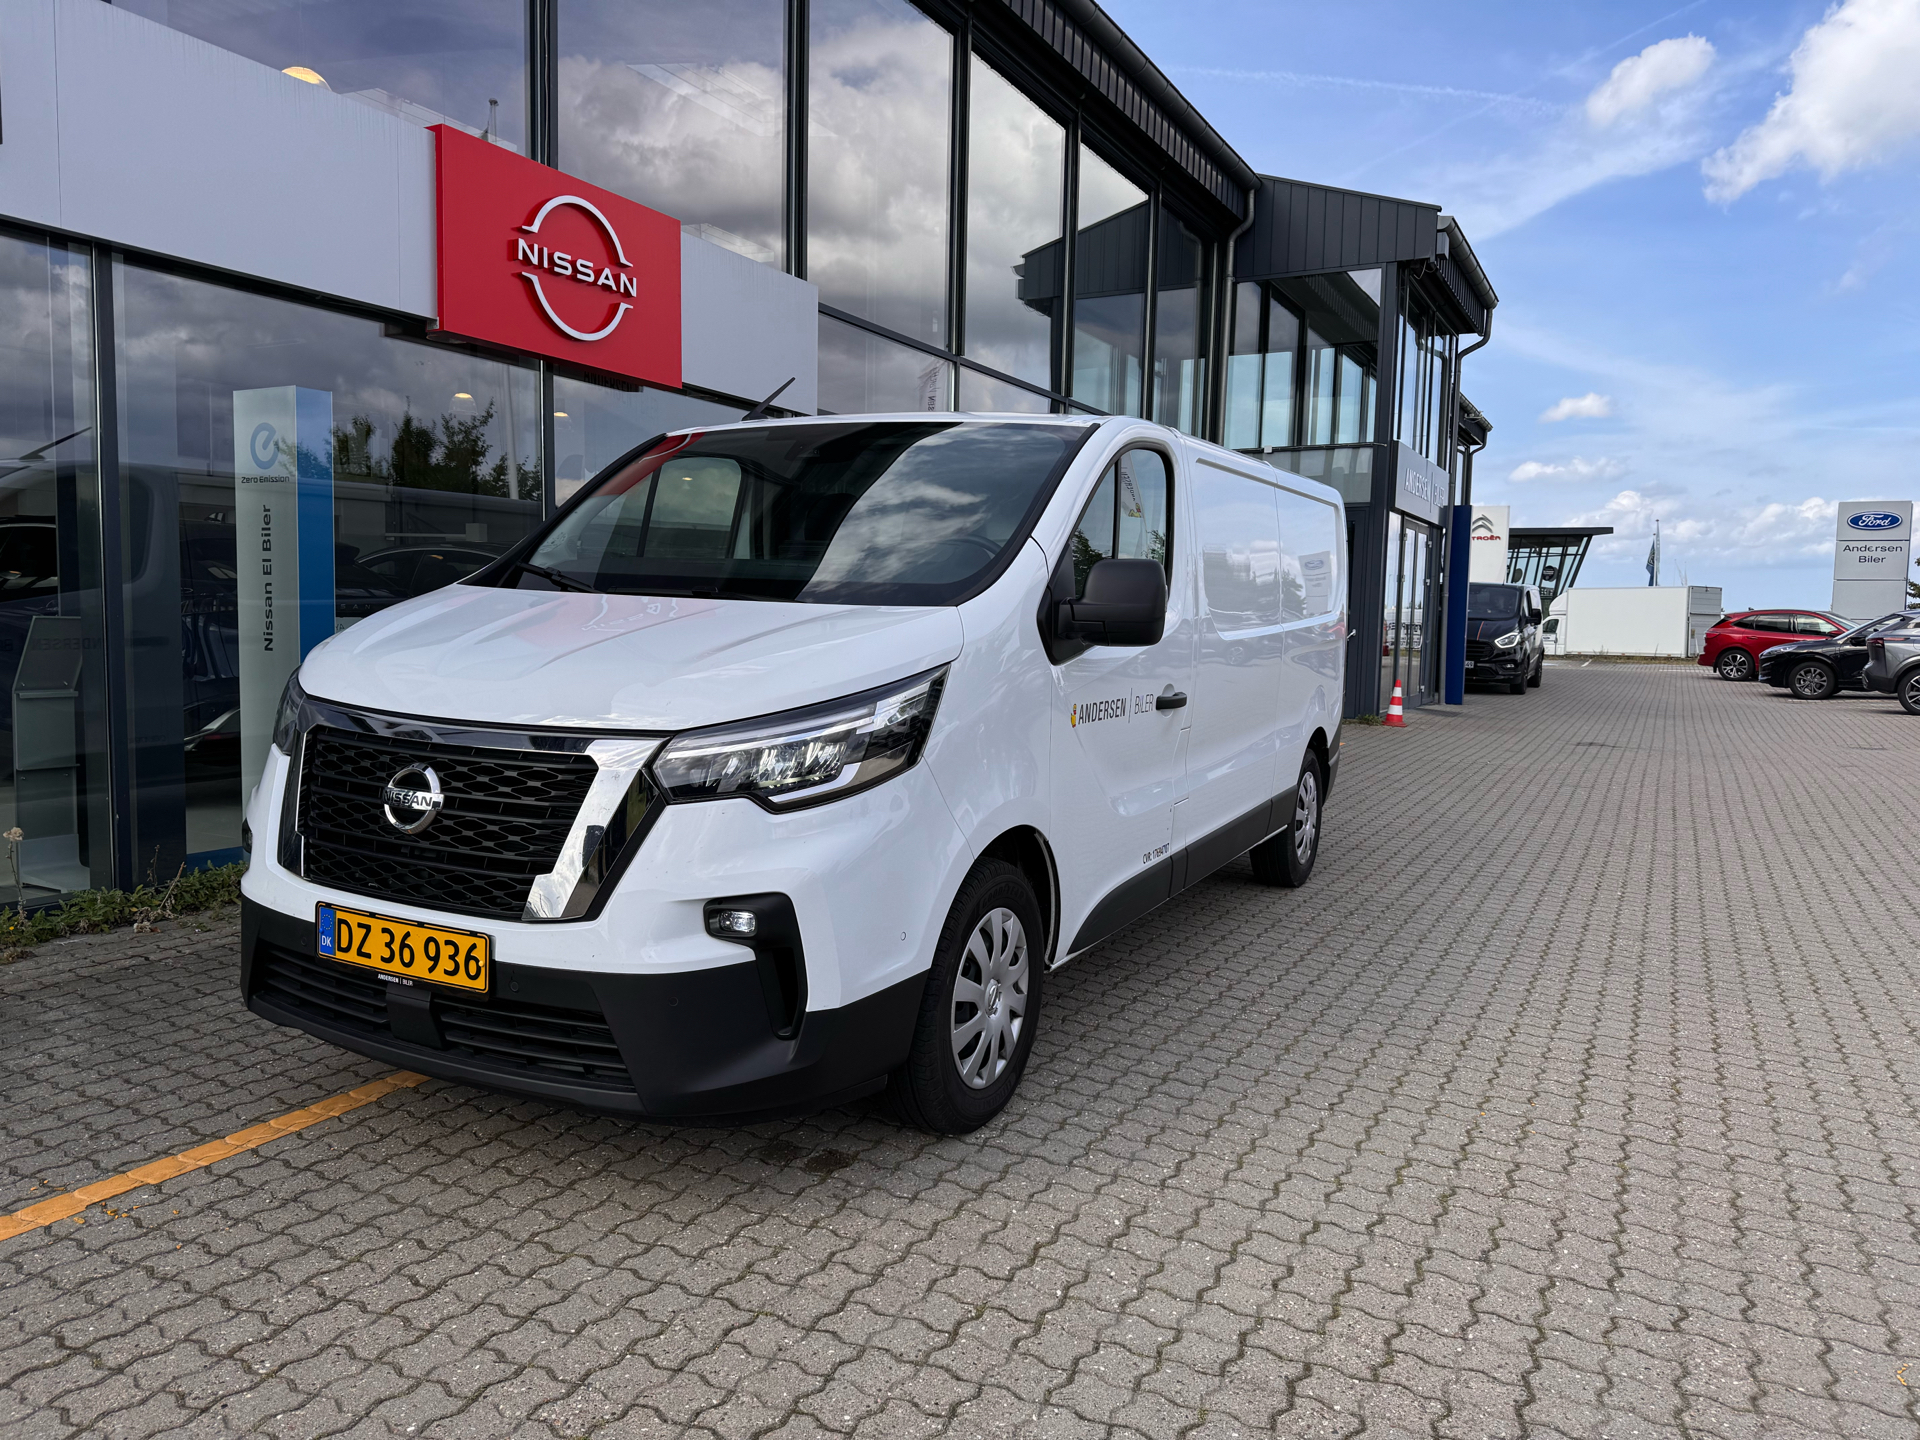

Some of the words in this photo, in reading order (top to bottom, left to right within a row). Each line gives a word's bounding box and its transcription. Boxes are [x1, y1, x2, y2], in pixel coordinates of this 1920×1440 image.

[518, 238, 637, 297] NISSAN
[259, 475, 289, 483] Emission
[261, 505, 272, 551] Biler
[1858, 514, 1892, 526] Ford
[1843, 544, 1903, 552] Andersen
[262, 558, 272, 575] El
[1858, 555, 1886, 563] Biler
[263, 582, 273, 651] Nissan
[1078, 698, 1127, 725] ANDERSEN
[1134, 694, 1154, 714] BILER
[383, 789, 433, 807] NISSAN
[321, 935, 332, 947] DK
[337, 918, 372, 959] DZ
[380, 927, 415, 968] 36
[423, 936, 482, 981] 936
[377, 973, 399, 984] ANDERSEN
[402, 978, 414, 987] BILER
